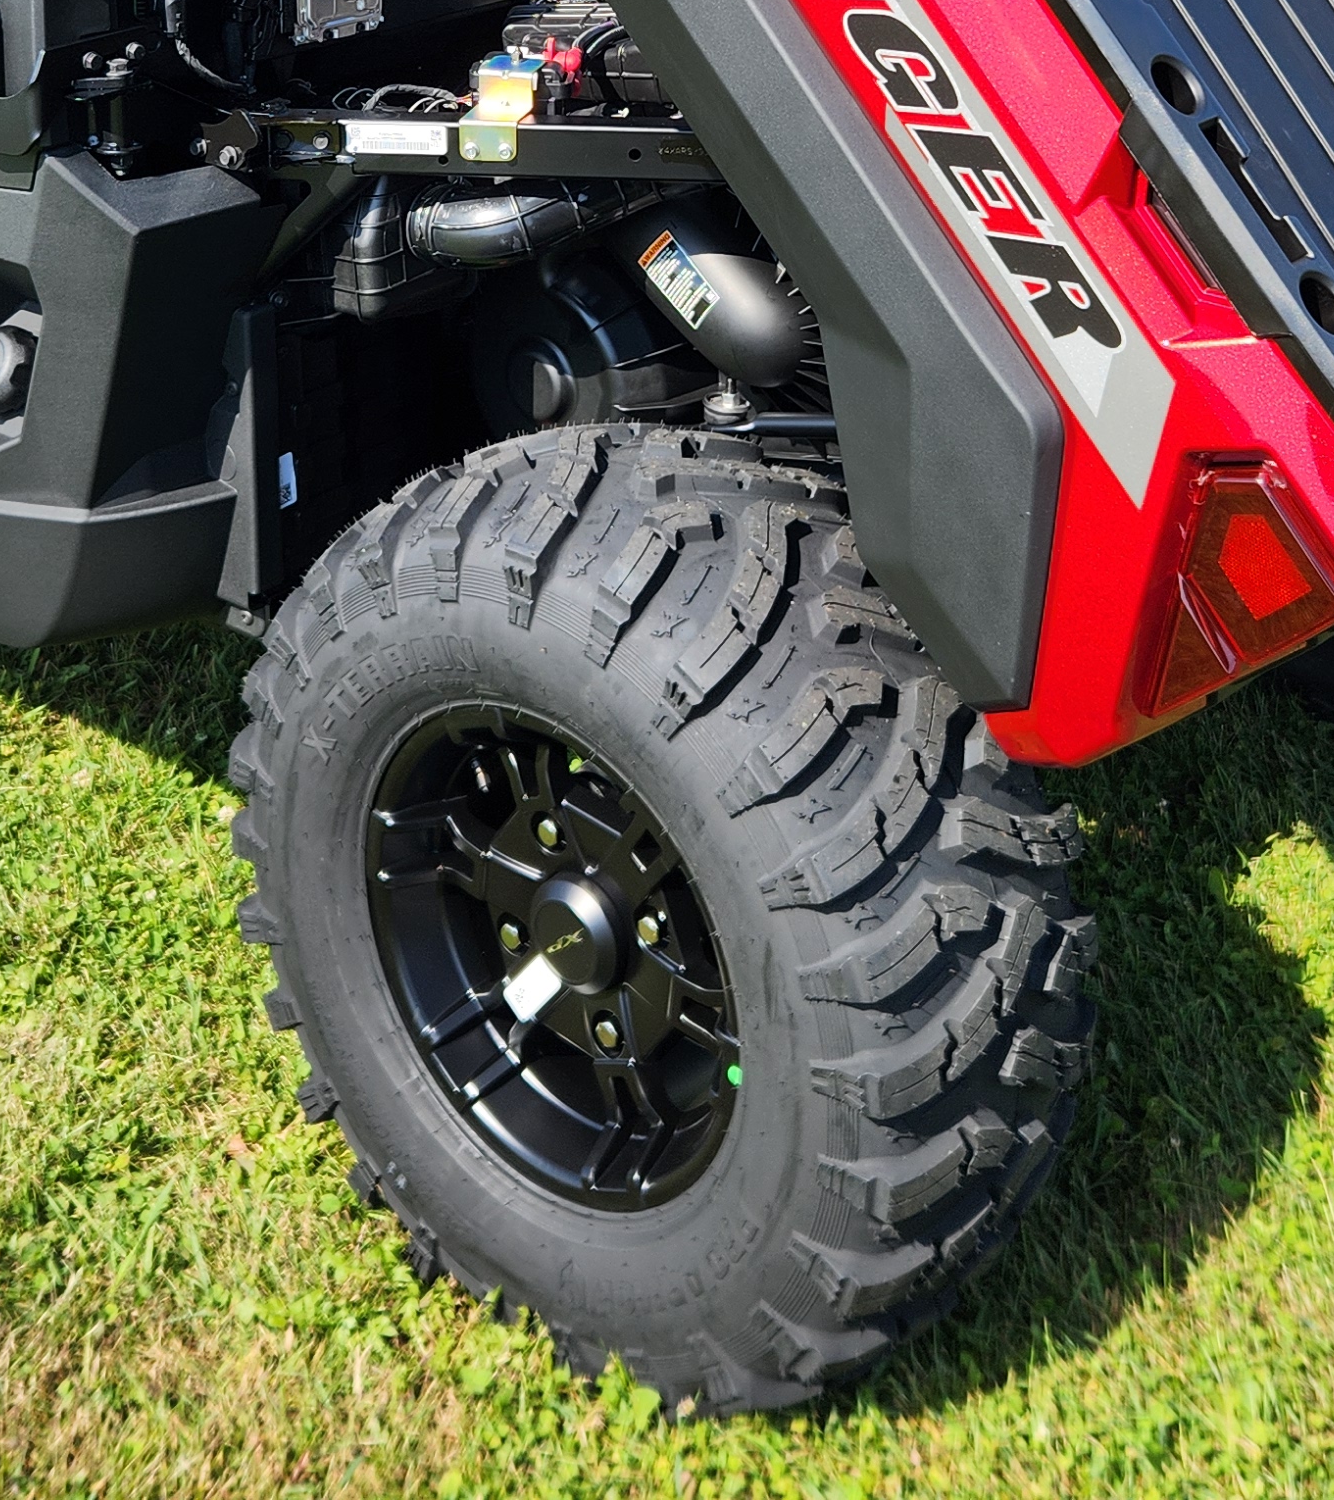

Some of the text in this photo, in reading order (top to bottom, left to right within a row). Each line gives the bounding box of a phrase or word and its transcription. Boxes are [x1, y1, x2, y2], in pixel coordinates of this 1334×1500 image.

[643, 232, 672, 263] WARNING
[301, 634, 481, 766] X-TERRAIN
[545, 927, 585, 954] XP
